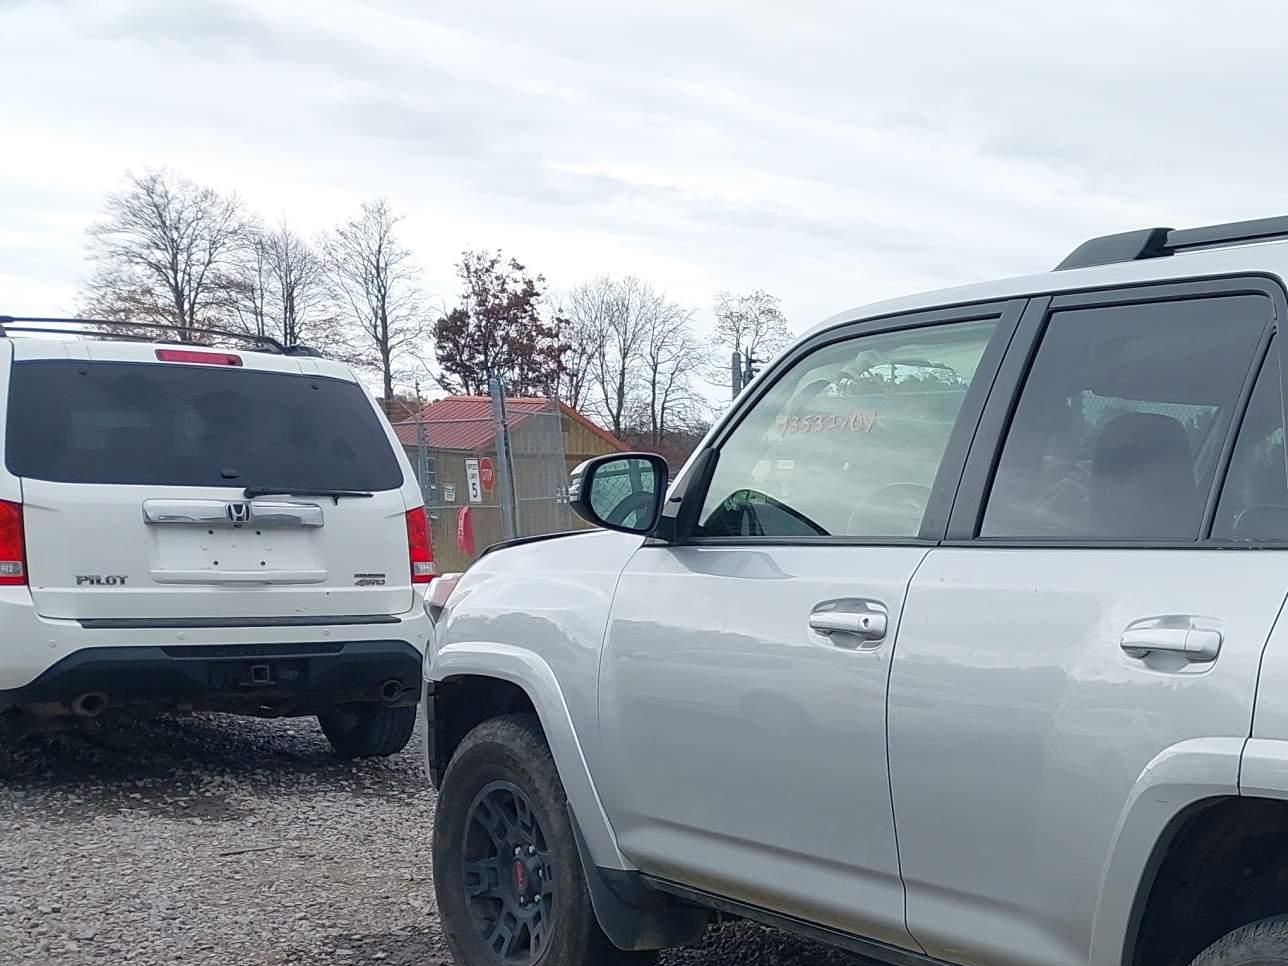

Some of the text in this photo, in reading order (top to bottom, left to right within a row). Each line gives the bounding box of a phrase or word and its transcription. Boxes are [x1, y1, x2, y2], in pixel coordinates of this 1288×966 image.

[481, 468, 493, 481] STOP
[471, 482, 478, 498] 5
[75, 575, 129, 586] PILOT
